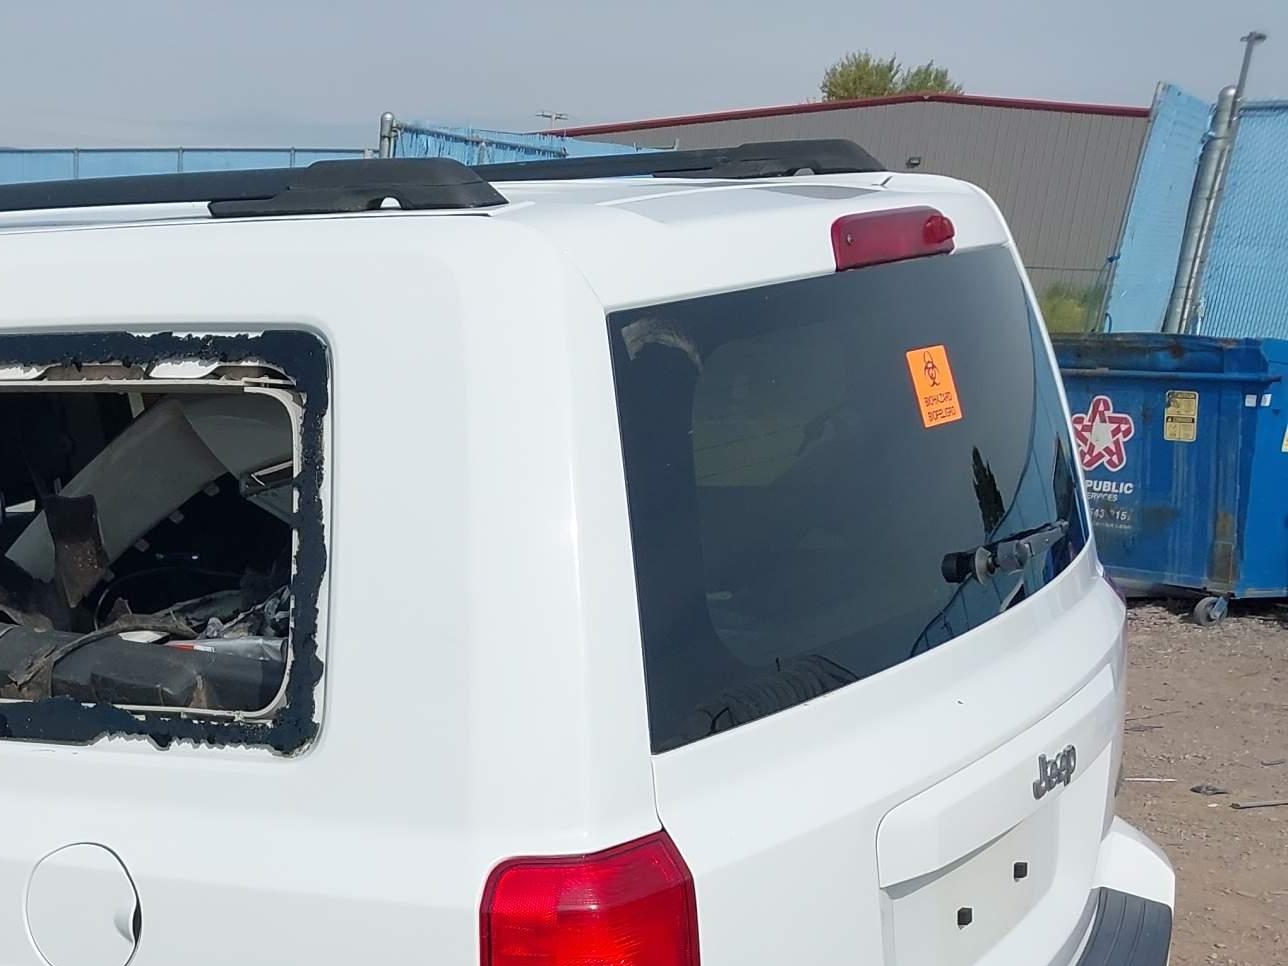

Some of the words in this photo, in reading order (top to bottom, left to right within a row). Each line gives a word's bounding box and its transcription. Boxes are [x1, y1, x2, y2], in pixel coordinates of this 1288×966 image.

[1085, 479, 1134, 494] PUBLIC
[1087, 492, 1118, 503] ERVICES
[1032, 744, 1077, 801] Jeep
